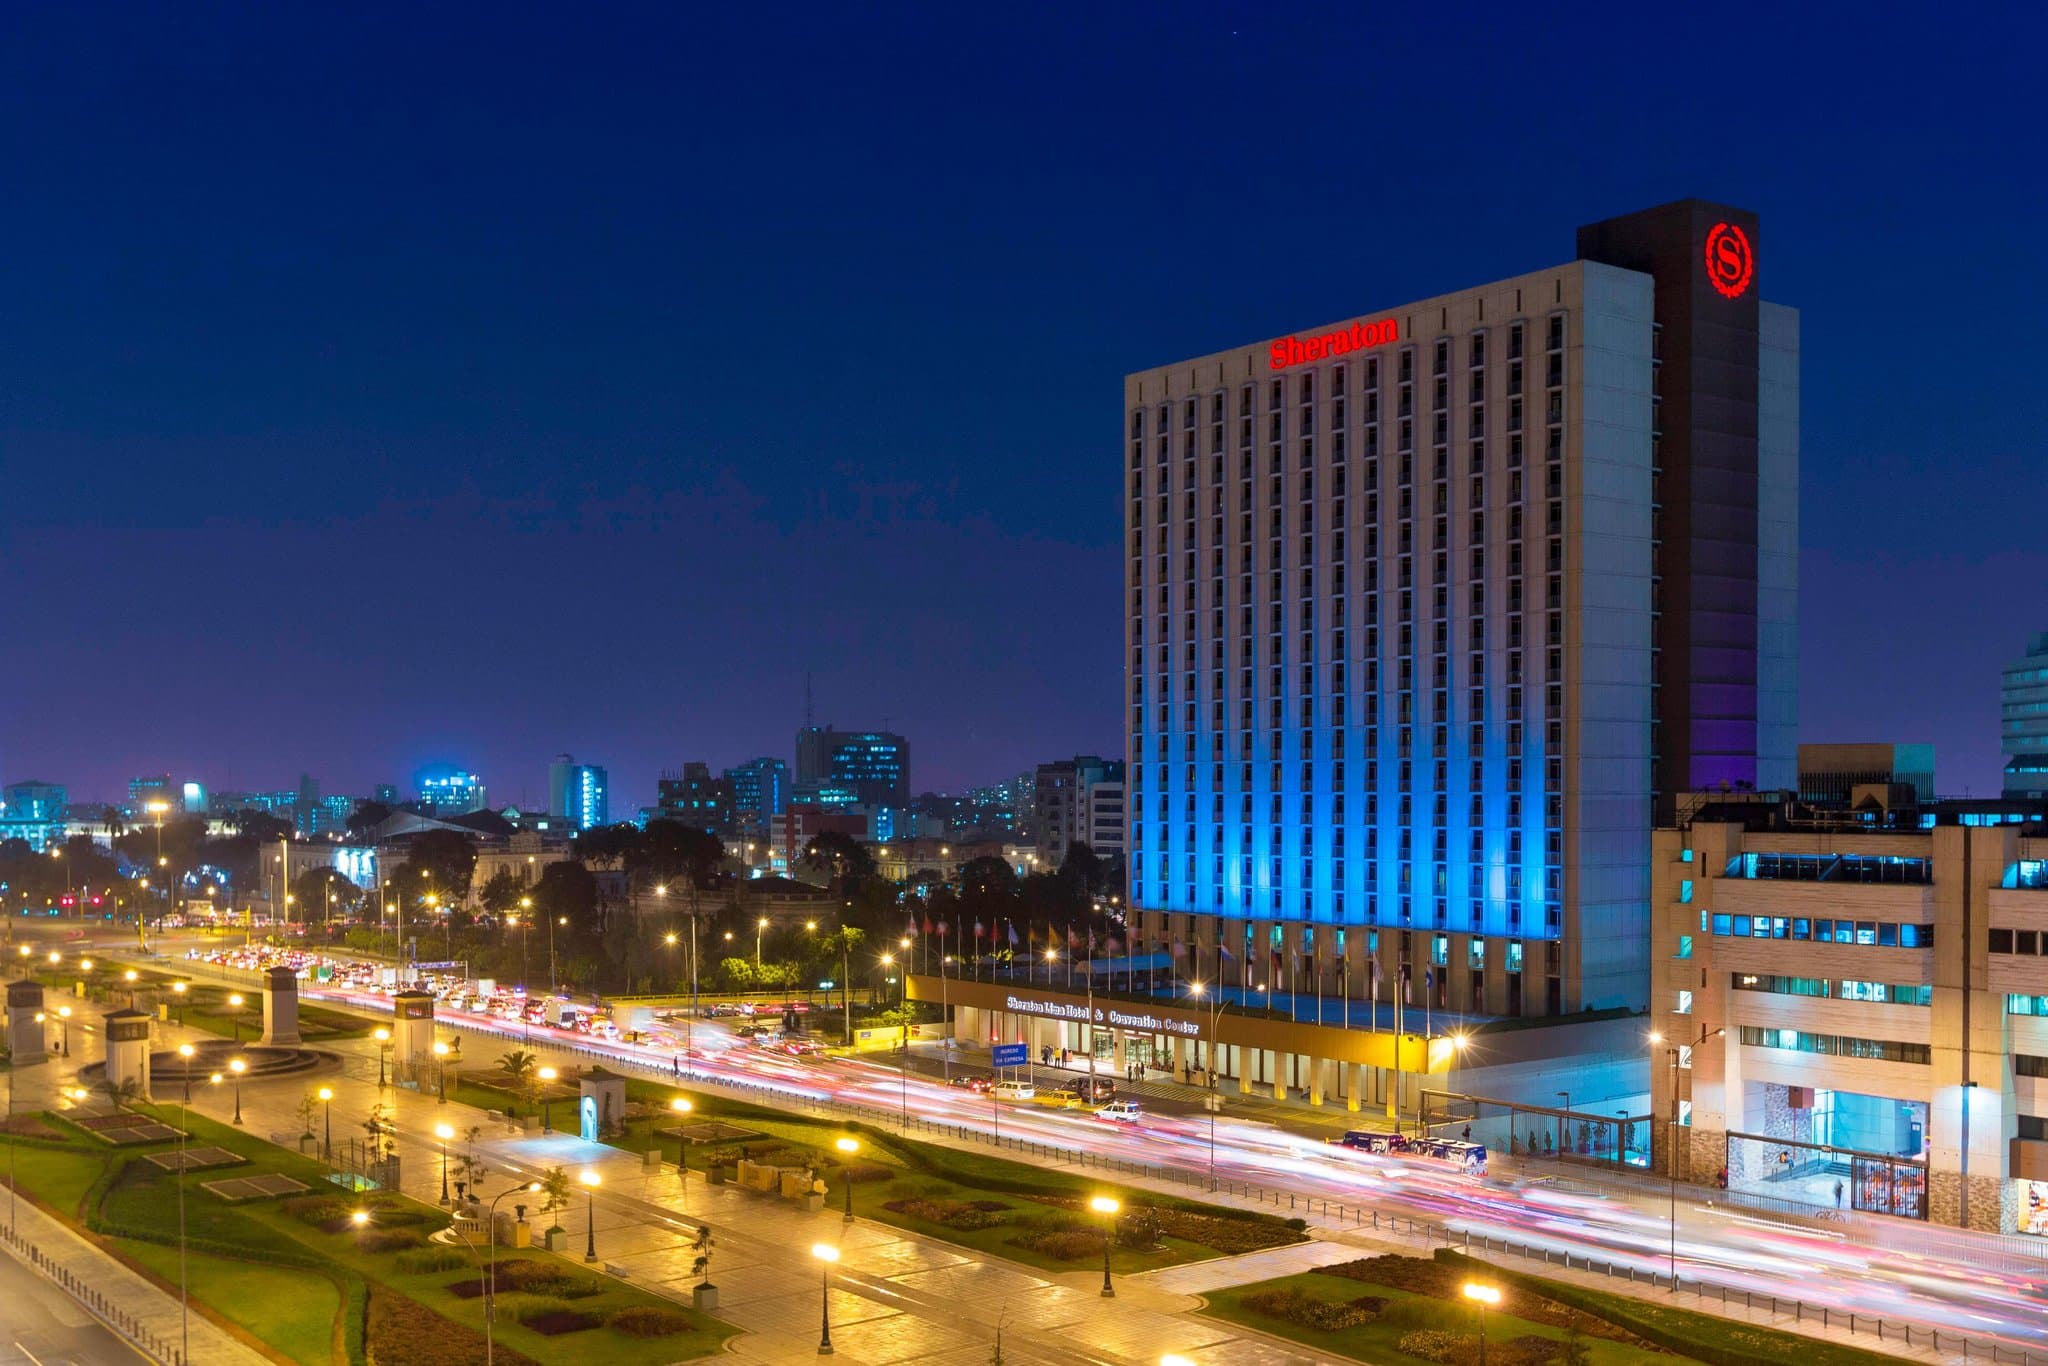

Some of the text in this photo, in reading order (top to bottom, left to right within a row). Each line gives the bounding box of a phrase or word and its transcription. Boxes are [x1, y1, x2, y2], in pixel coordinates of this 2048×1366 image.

[1270, 318, 1399, 369] Sheraton
[1007, 996, 1199, 1034] Sheraton Lima Hotel & Convention Center
